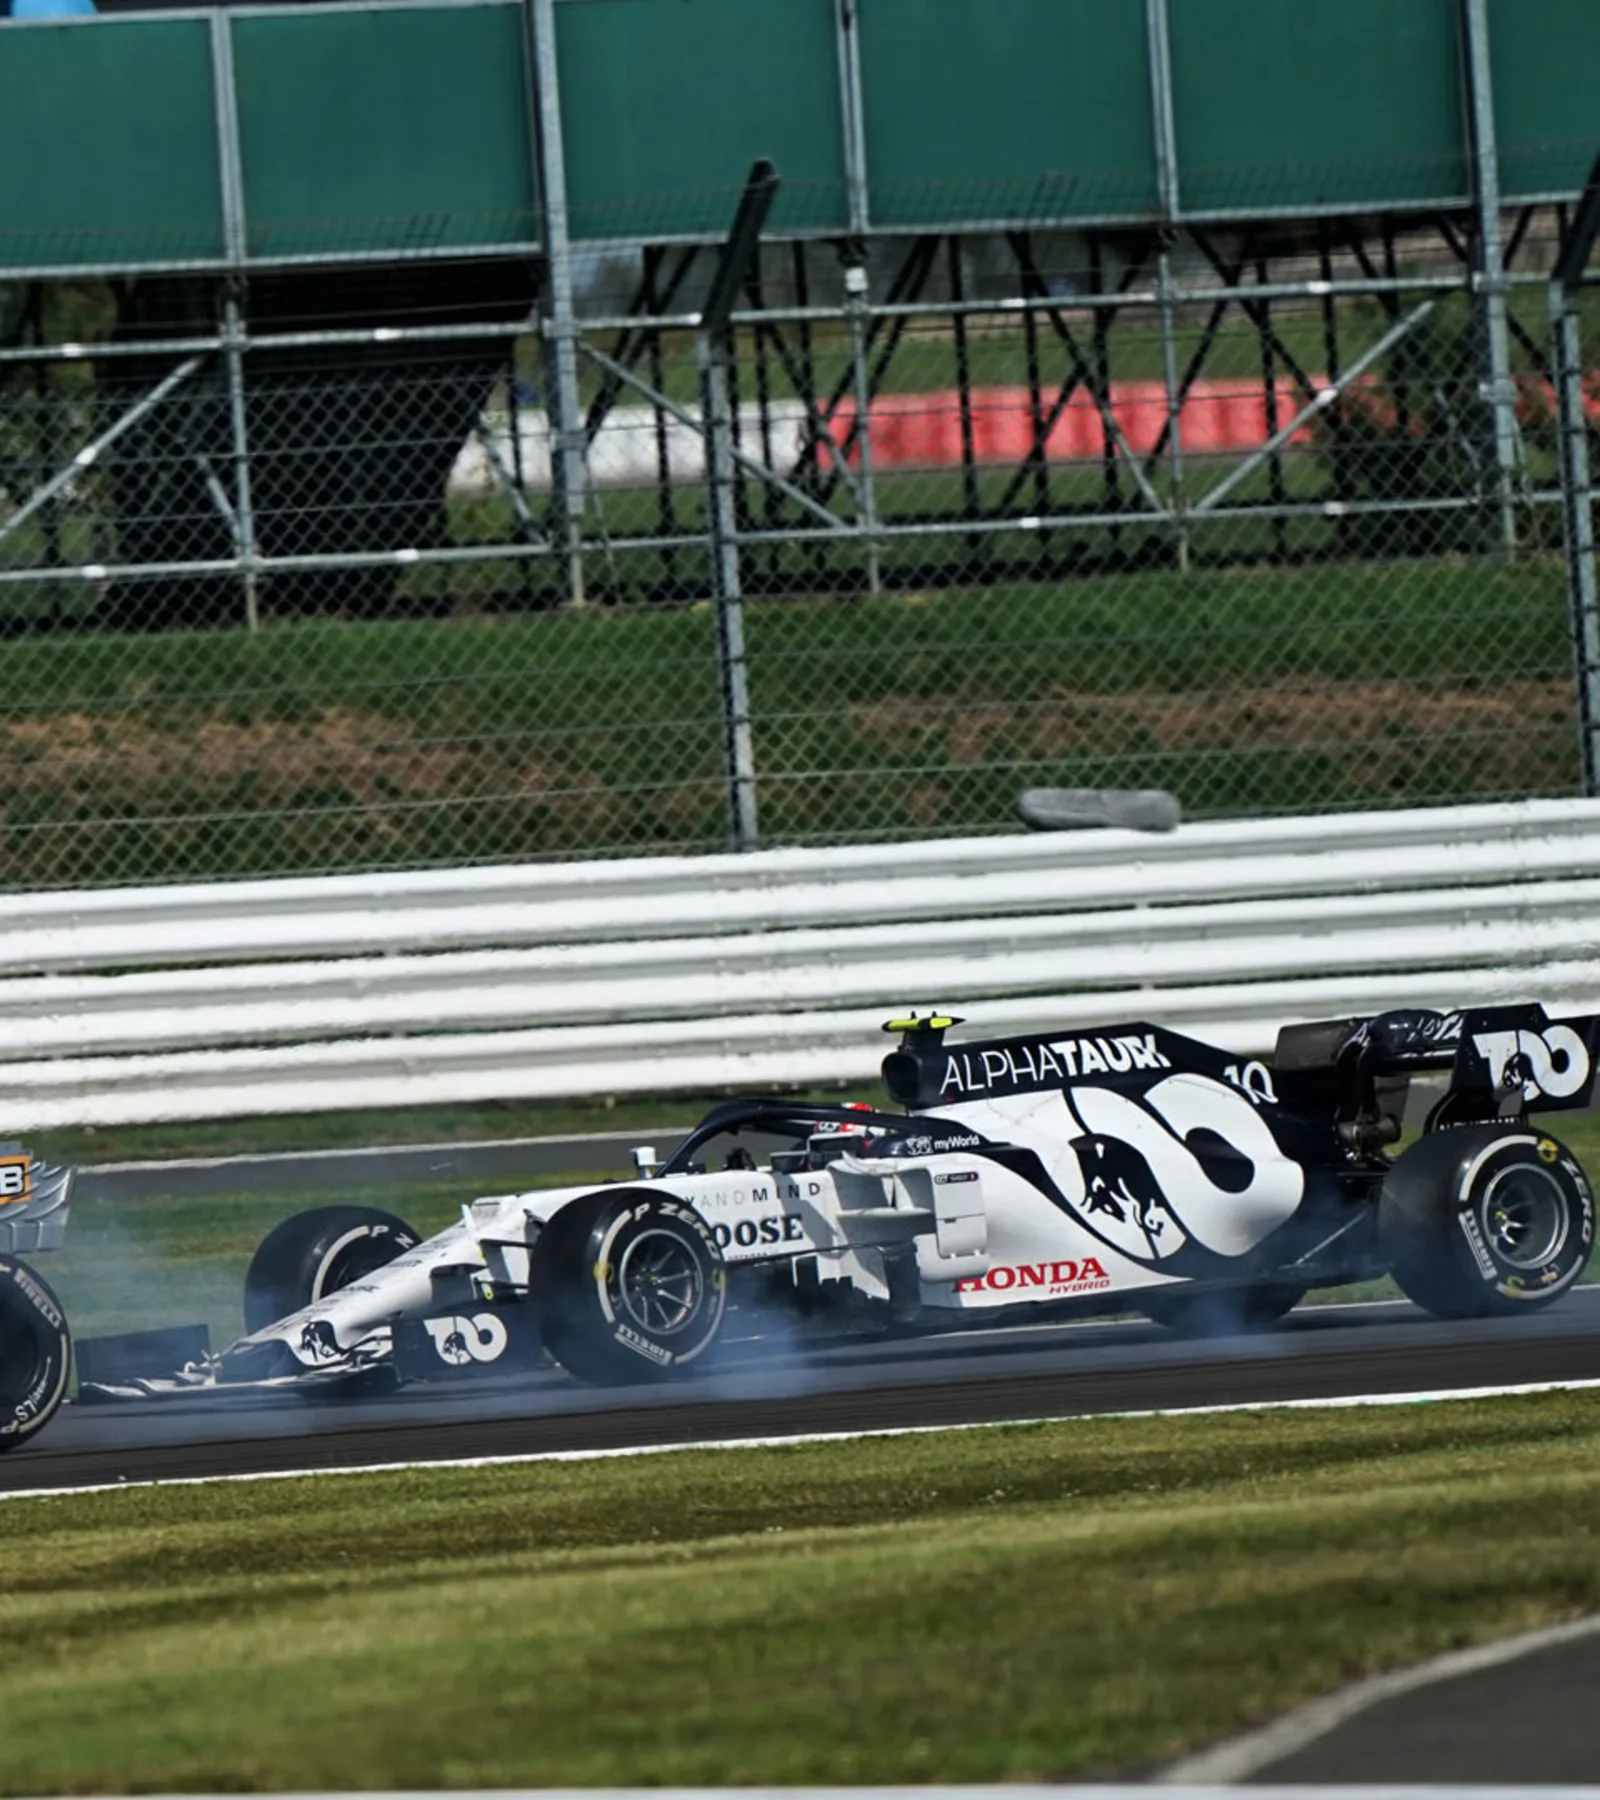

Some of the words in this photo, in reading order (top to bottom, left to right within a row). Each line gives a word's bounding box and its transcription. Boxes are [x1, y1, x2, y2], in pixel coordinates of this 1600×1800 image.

[1223, 1060, 1279, 1104] 10
[934, 1134, 980, 1151] myWorld
[752, 1182, 821, 1201] MIND
[633, 1202, 650, 1221] P
[658, 1202, 721, 1260] ZERO
[711, 1213, 804, 1249] OOSE
[14, 1268, 62, 1329] PIRELLI
[1048, 1278, 1111, 1294] HYBRID
